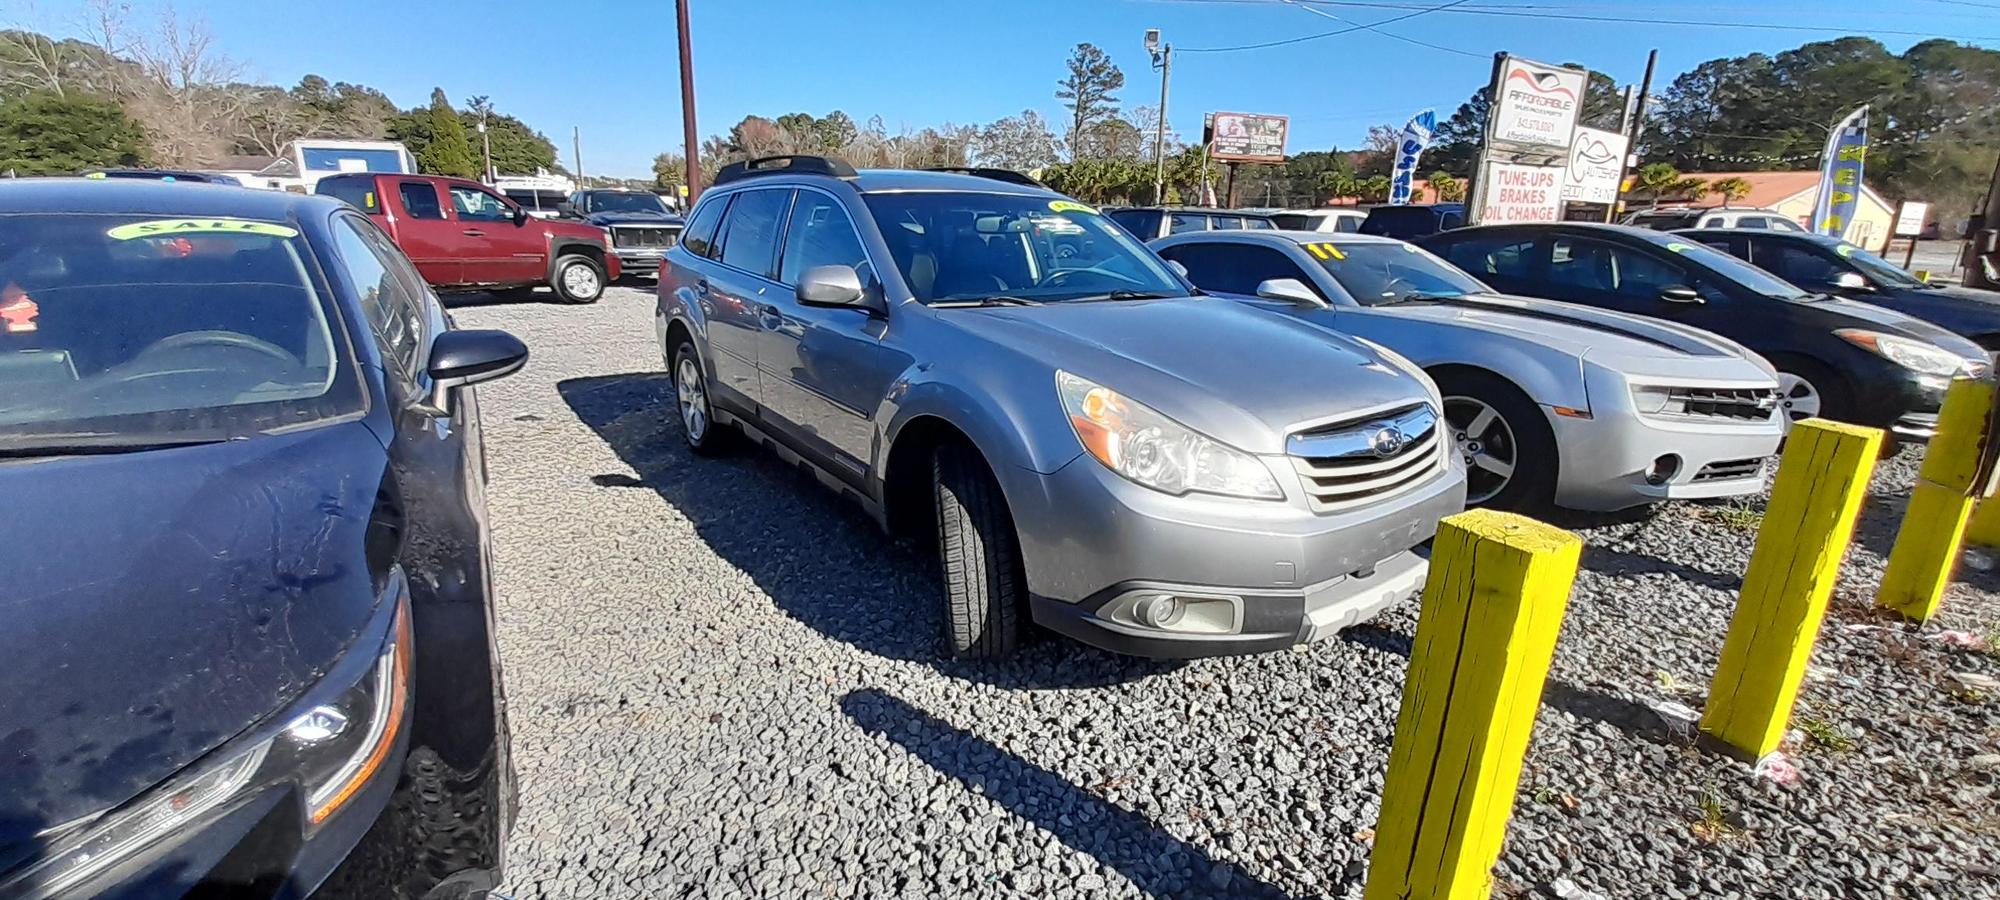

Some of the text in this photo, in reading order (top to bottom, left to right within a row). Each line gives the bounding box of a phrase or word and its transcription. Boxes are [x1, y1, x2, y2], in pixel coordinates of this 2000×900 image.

[1509, 90, 1572, 111] AFFORDABLE
[1498, 170, 1554, 187] TUNE-UPS
[1499, 188, 1546, 203] BRAKES
[1591, 187, 1616, 200] PAINT
[1484, 206, 1555, 221] OIL CHANGE
[139, 221, 264, 232] SALE
[1307, 243, 1345, 260] 11
